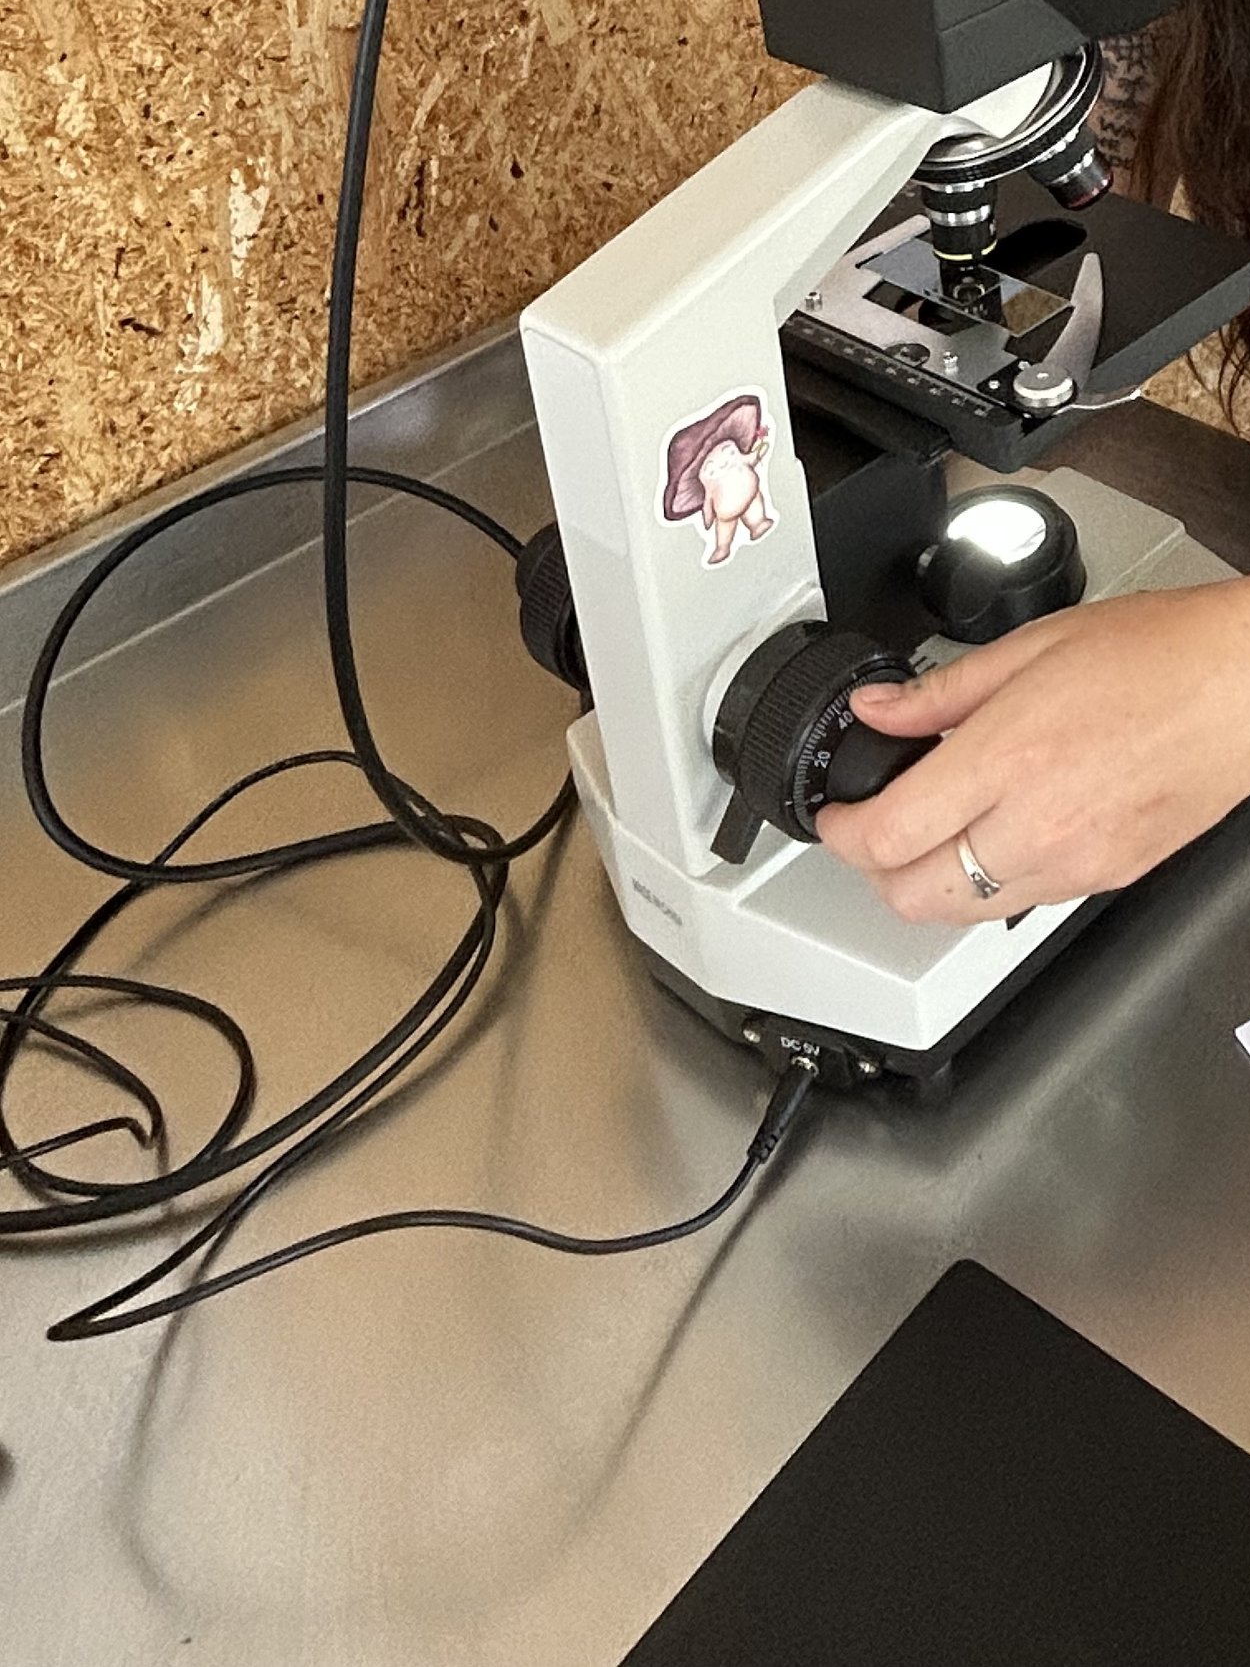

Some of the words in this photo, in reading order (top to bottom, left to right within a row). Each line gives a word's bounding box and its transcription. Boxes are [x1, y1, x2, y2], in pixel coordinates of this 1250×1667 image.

[838, 710, 854, 729] 40
[814, 750, 831, 769] 20
[780, 1036, 802, 1052] DC
